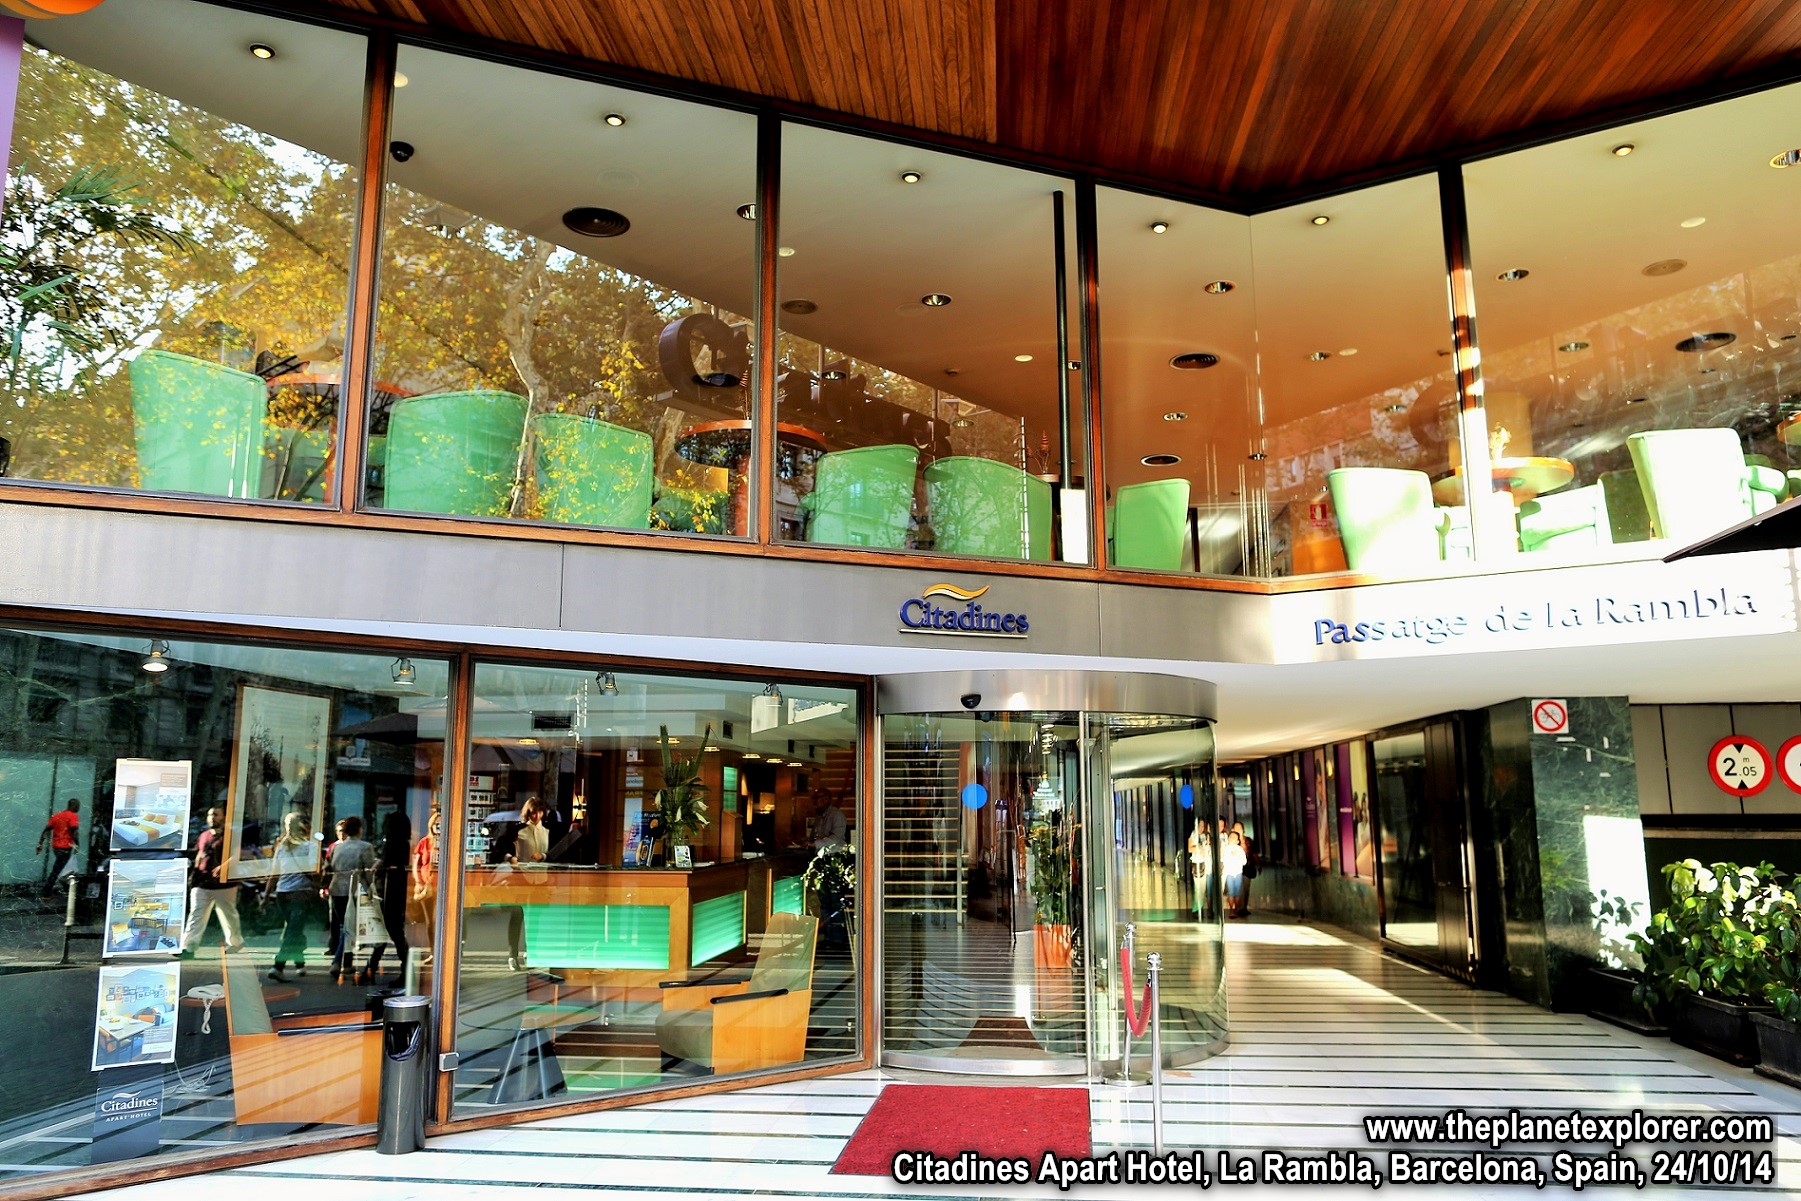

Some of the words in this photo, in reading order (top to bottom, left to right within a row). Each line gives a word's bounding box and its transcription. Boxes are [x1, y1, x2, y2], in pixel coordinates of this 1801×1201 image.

[899, 598, 1030, 632] Citadines
[1314, 616, 1468, 645] Passatge
[1486, 606, 1533, 633] de
[1547, 602, 1583, 628] la
[1596, 587, 1758, 625] Rambla
[101, 1097, 158, 1112] Citadines
